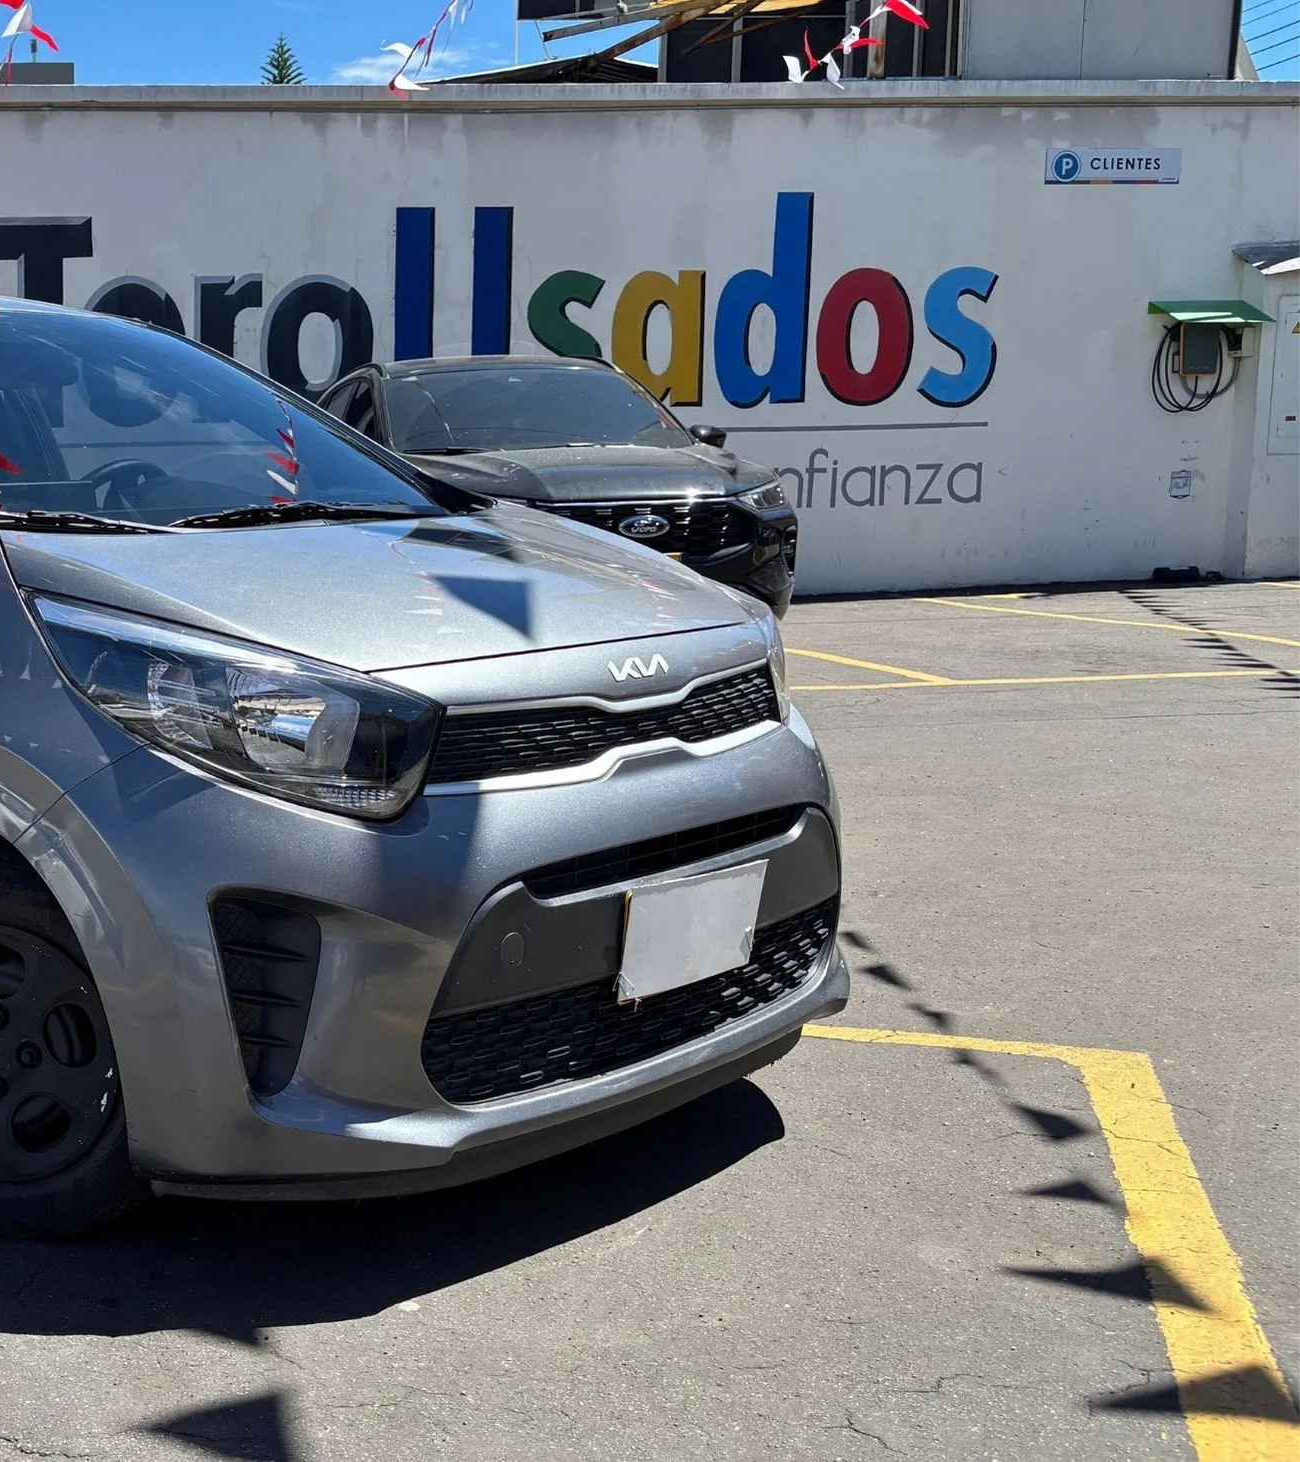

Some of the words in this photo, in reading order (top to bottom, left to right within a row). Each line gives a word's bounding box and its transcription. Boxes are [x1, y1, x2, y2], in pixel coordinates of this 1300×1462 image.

[1090, 157, 1162, 171] CLIENTES
[773, 447, 983, 509] nfianza
[607, 652, 670, 683] KIA
